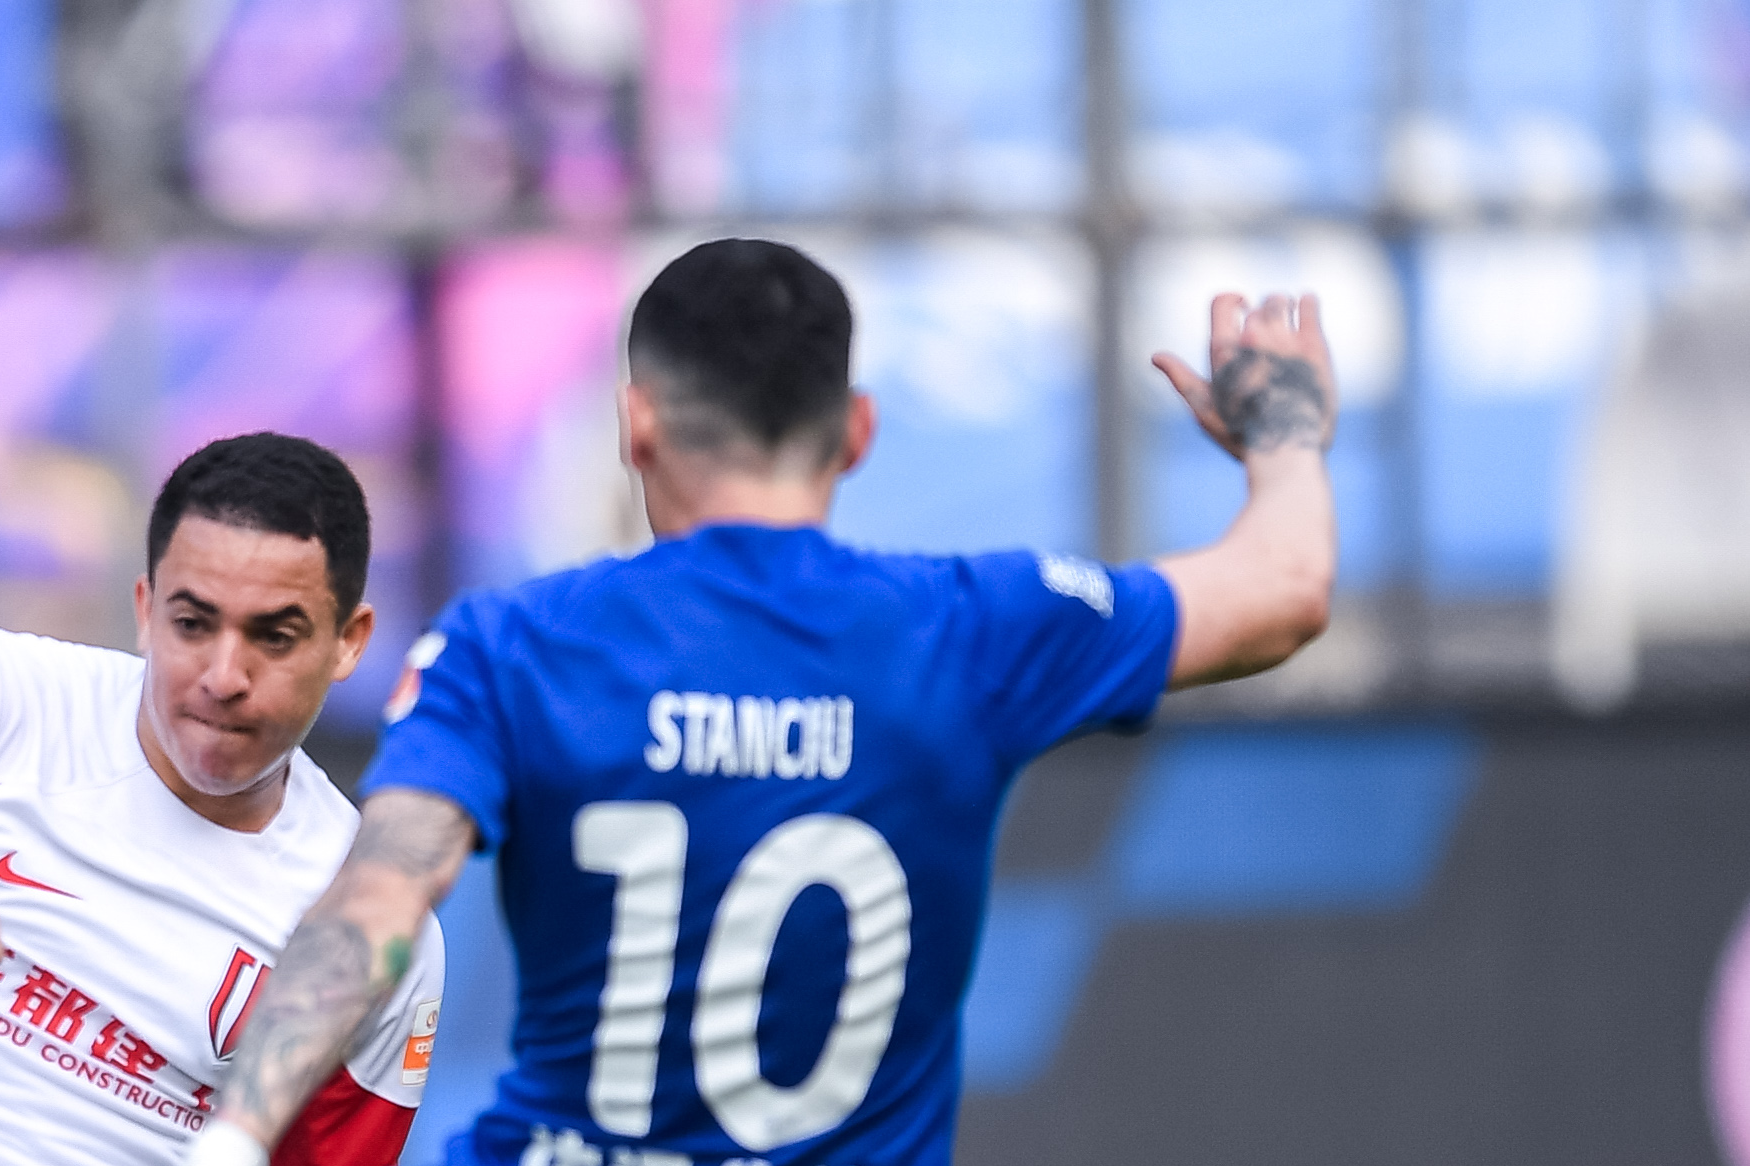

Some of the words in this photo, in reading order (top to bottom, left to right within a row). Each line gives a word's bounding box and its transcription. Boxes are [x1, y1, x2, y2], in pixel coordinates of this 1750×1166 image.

[643, 689, 854, 780] STANCIU
[572, 801, 912, 1151] 10
[41, 1043, 205, 1132] CONSTRUCTIO
